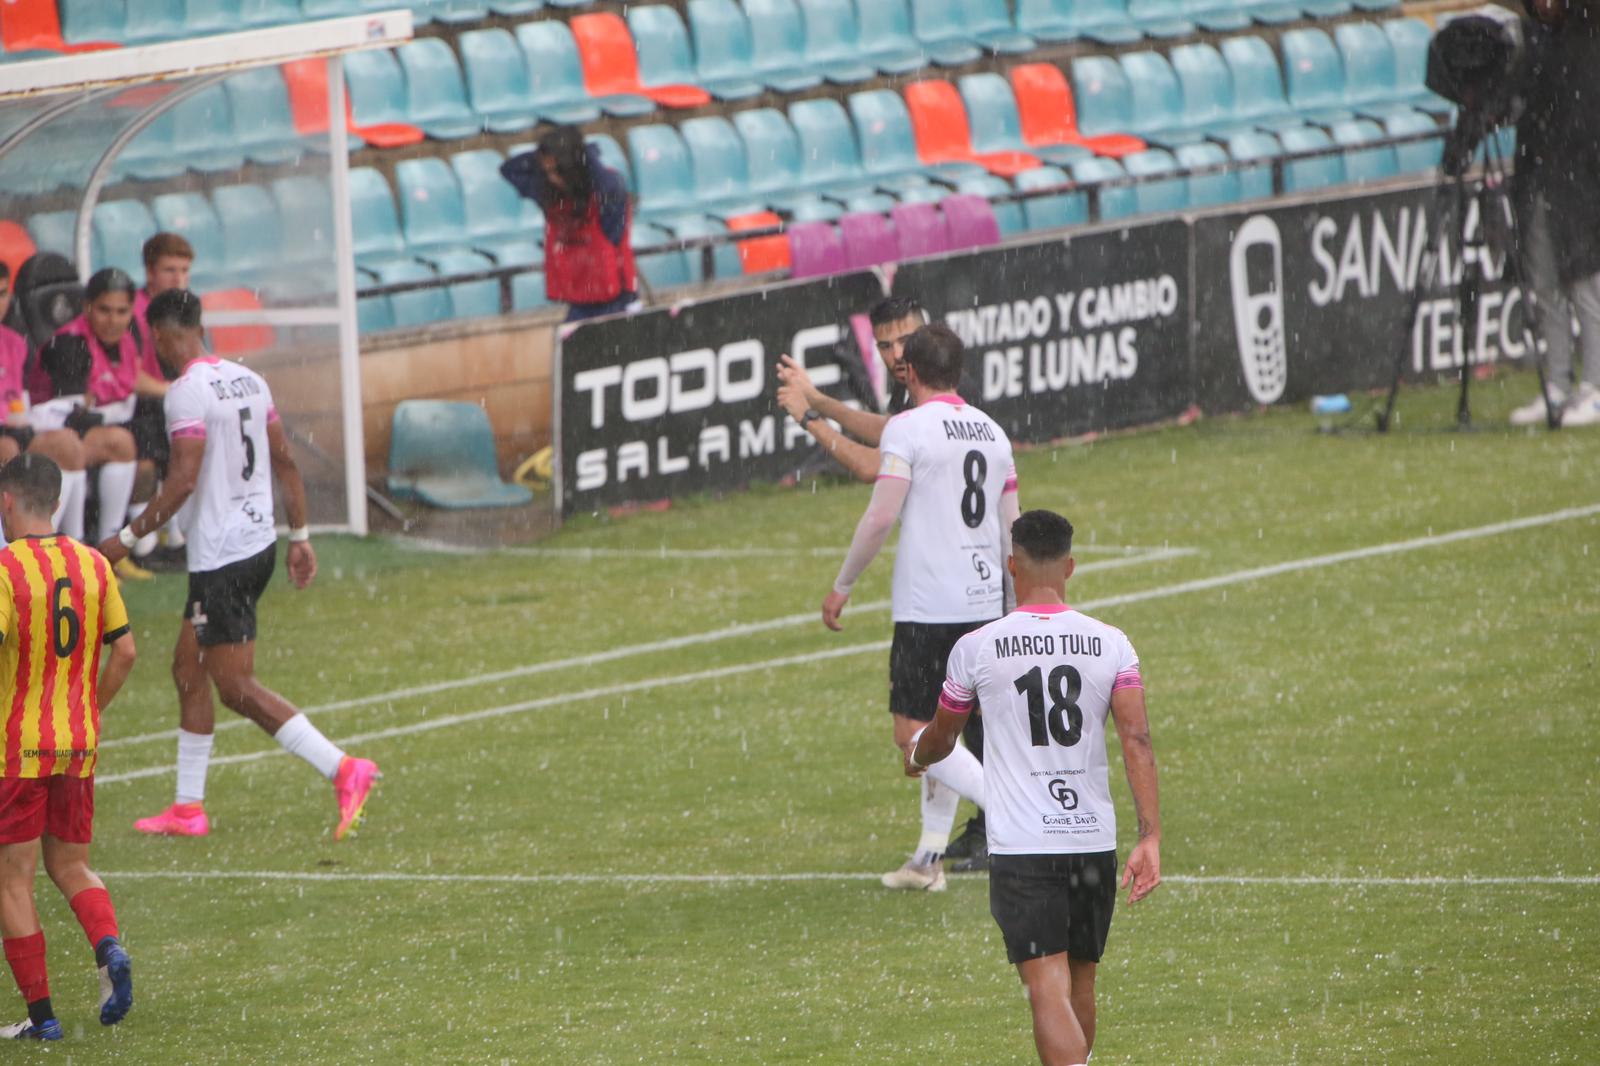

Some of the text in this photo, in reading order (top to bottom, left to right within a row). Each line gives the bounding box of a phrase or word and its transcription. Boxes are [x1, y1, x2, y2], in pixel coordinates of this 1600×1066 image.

[945, 274, 1178, 349] TINTADO Y CAMBIO
[573, 338, 765, 429] TODO
[982, 326, 1138, 400] DE LUNAS
[239, 407, 255, 481] 5
[942, 419, 996, 442] AMARO
[960, 449, 988, 529] 8
[52, 577, 80, 659] 6
[995, 634, 1102, 659] MARCO TULIO
[1013, 664, 1083, 747] 18
[1042, 815, 1097, 825] CONDE DAVID
